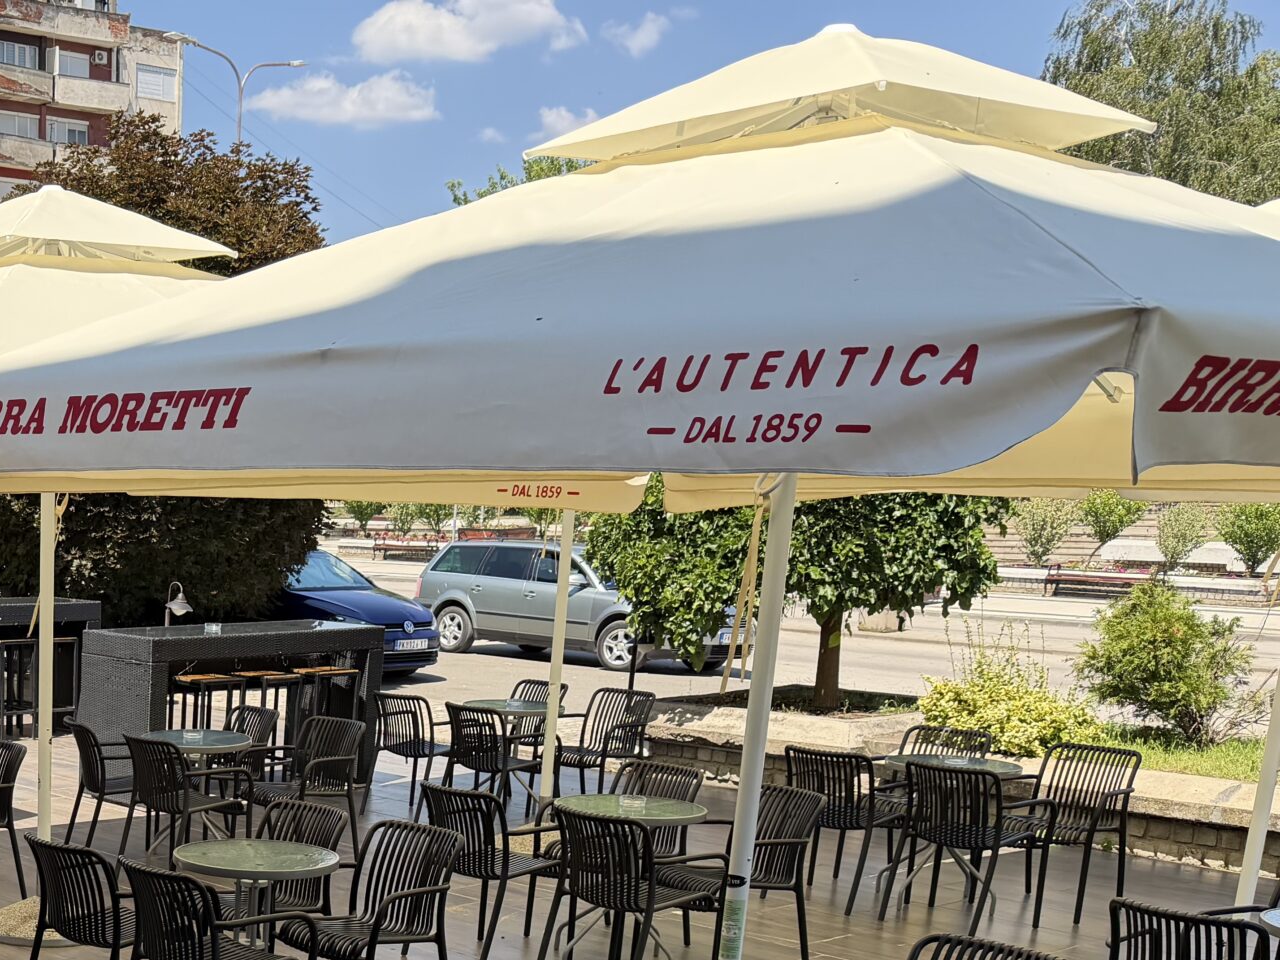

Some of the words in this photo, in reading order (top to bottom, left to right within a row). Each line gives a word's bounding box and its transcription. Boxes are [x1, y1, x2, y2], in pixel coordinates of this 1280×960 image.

[603, 343, 980, 395] L'AUTENTICA
[58, 386, 253, 435] MORETTI
[683, 415, 736, 444] DAL
[745, 413, 822, 443] 1859
[511, 484, 532, 498] DAL
[535, 485, 562, 499] 1859
